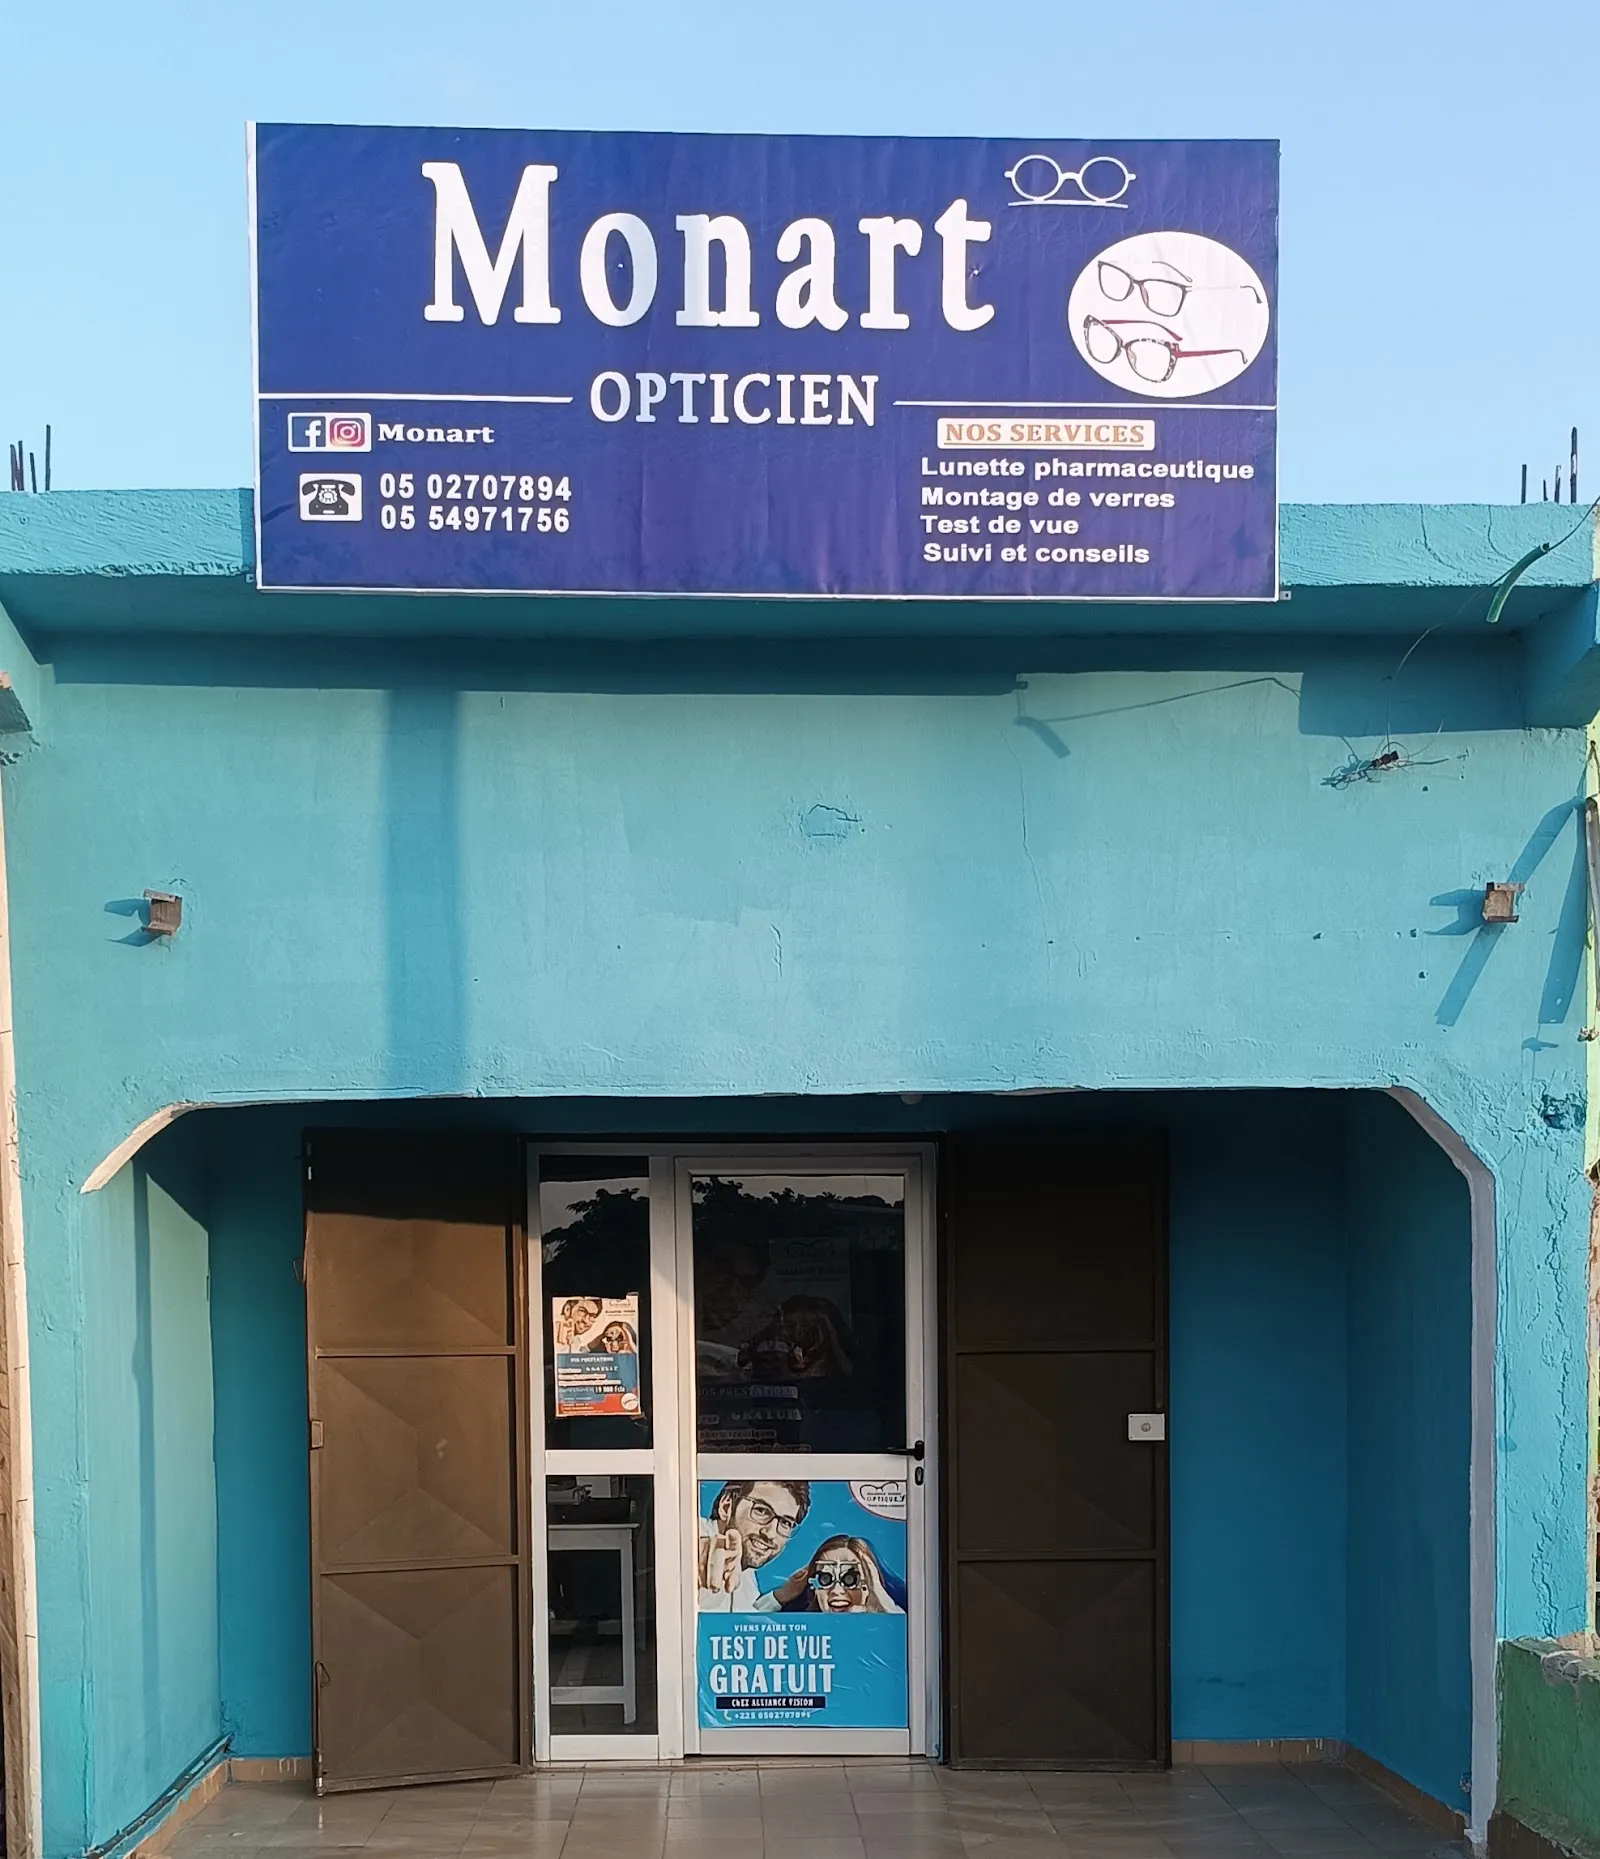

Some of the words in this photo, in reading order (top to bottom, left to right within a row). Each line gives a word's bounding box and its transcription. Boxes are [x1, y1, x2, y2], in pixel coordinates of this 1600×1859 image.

[421, 161, 995, 332] Monart
[590, 371, 879, 426] OPTICIEN
[377, 424, 495, 444] Monart
[945, 423, 1002, 442] NOS
[1009, 424, 1145, 444] SERVICES
[921, 456, 1025, 477] Lunette
[1034, 458, 1255, 483] pharmaceutique
[379, 472, 415, 498] 05
[427, 474, 572, 501] 02707894
[921, 487, 1040, 510] Montage
[1048, 487, 1081, 507] de
[1088, 492, 1176, 508] verres
[380, 504, 416, 530] 05
[428, 506, 570, 532] 54971756
[919, 514, 981, 534] Test
[987, 515, 1022, 534] de
[1029, 519, 1079, 534] vue
[923, 542, 992, 562] Suivi
[1000, 543, 1028, 562] et
[1035, 544, 1150, 564] conseils
[734, 1624, 759, 1632] VIENS
[761, 1624, 787, 1632] FAIRE
[709, 1635, 757, 1660] TEST
[764, 1635, 789, 1660] DE
[796, 1635, 833, 1660] VUE
[709, 1663, 836, 1694] GRATUIT
[751, 1698, 786, 1707] ALLIANCE
[788, 1697, 814, 1707] VISION
[734, 1711, 756, 1720] +225
